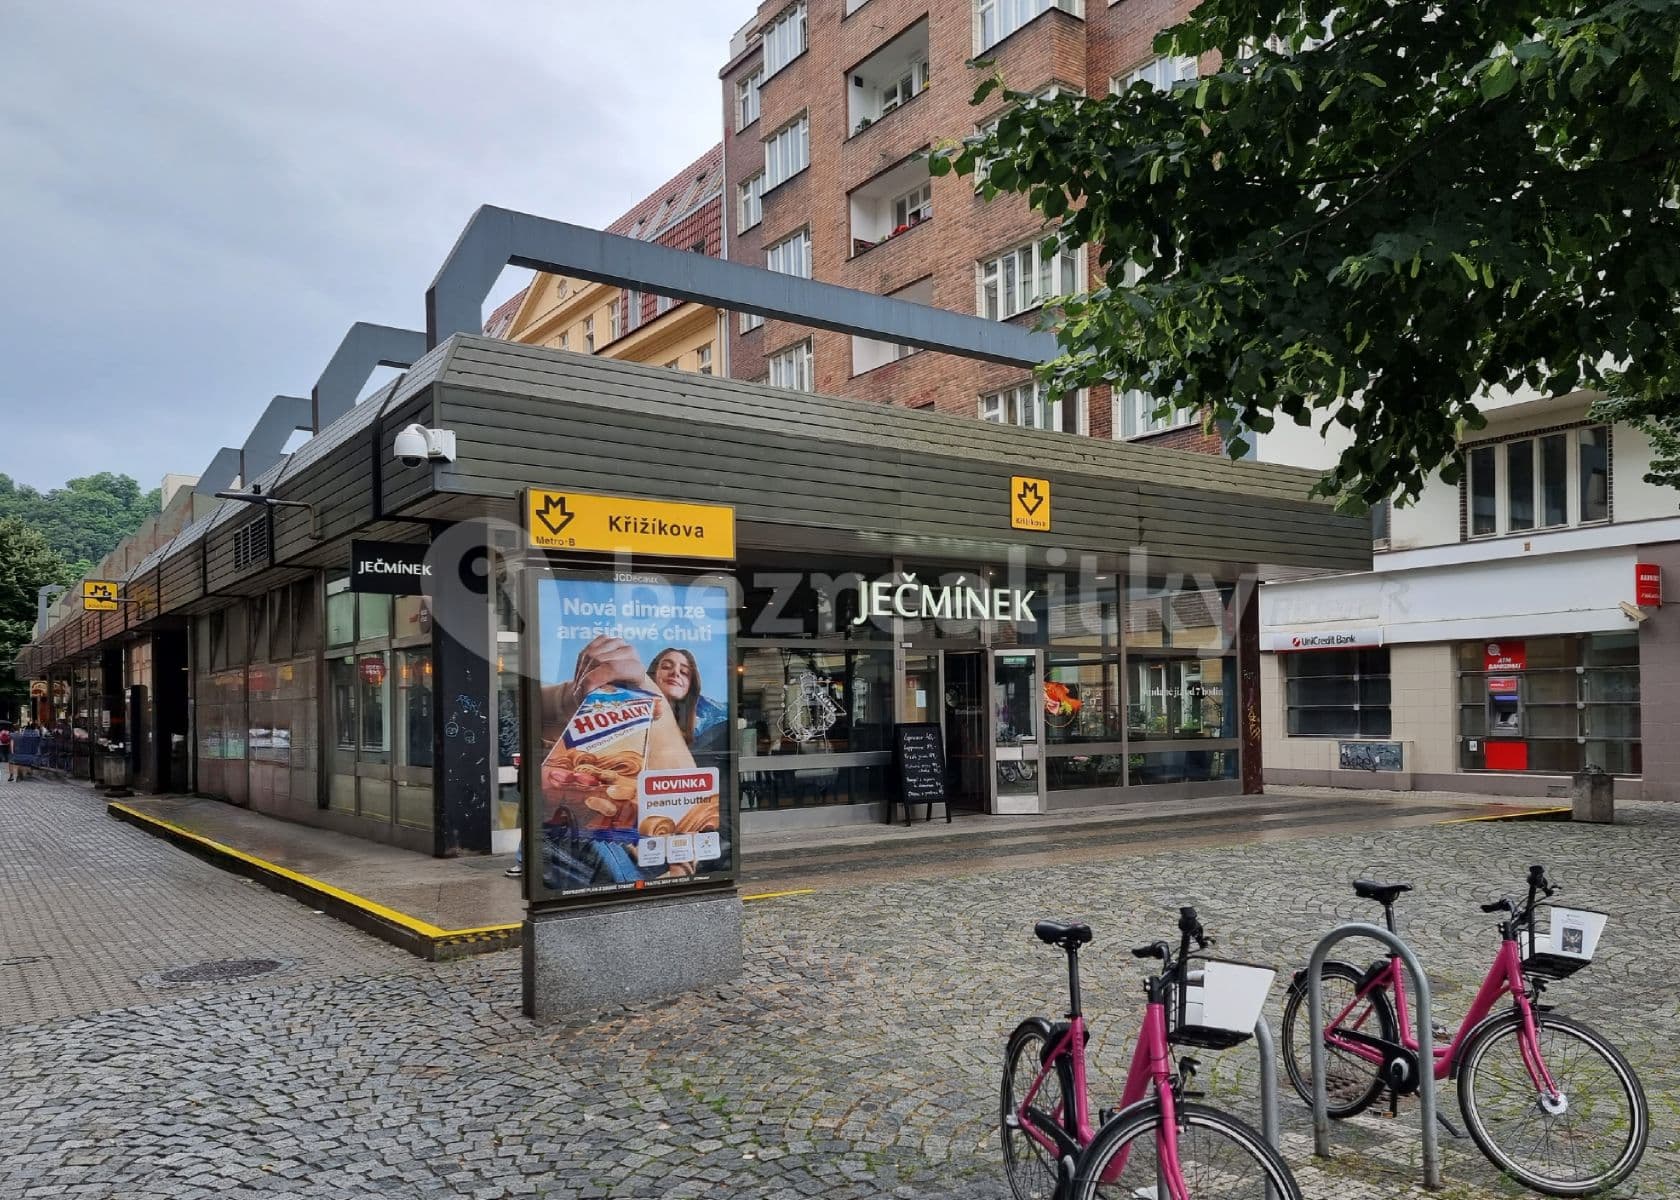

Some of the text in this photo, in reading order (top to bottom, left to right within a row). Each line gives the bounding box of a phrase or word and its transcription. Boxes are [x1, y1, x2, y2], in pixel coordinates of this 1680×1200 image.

[608, 515, 704, 538] Křižíkova
[357, 557, 432, 576] JEČMÍNEK
[563, 597, 706, 619] Nová dimenze
[853, 571, 1036, 625] JEČMÍNEK
[557, 621, 712, 641] arašídové chuti
[1302, 635, 1356, 646] UniCredit Bank
[574, 704, 649, 734] HORALKY
[652, 778, 706, 791] NOVINKA
[646, 795, 712, 809] peanut butter
